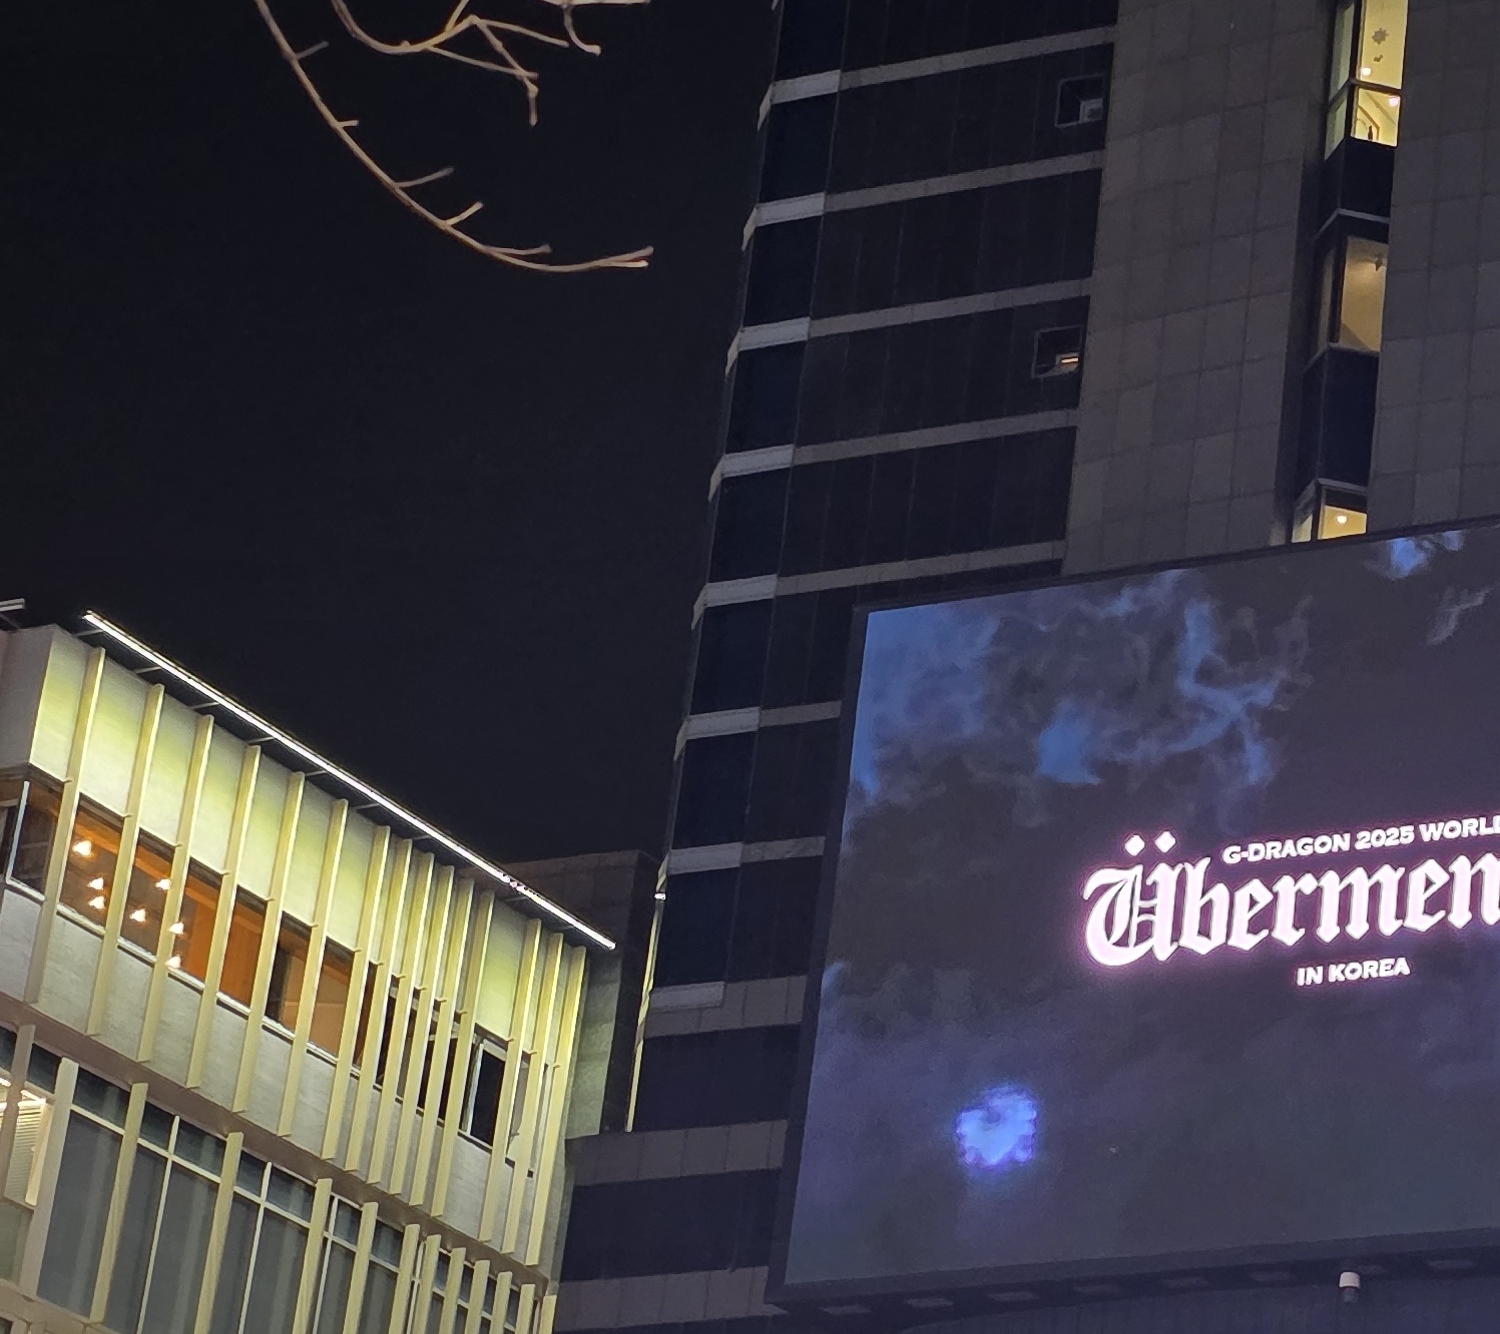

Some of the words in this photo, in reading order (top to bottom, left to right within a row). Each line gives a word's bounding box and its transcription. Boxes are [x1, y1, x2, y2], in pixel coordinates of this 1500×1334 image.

[1222, 832, 1351, 864] G-DRAGON
[1354, 825, 1415, 851] 2025
[1297, 967, 1324, 987] IN
[1327, 956, 1411, 982] KOREA
